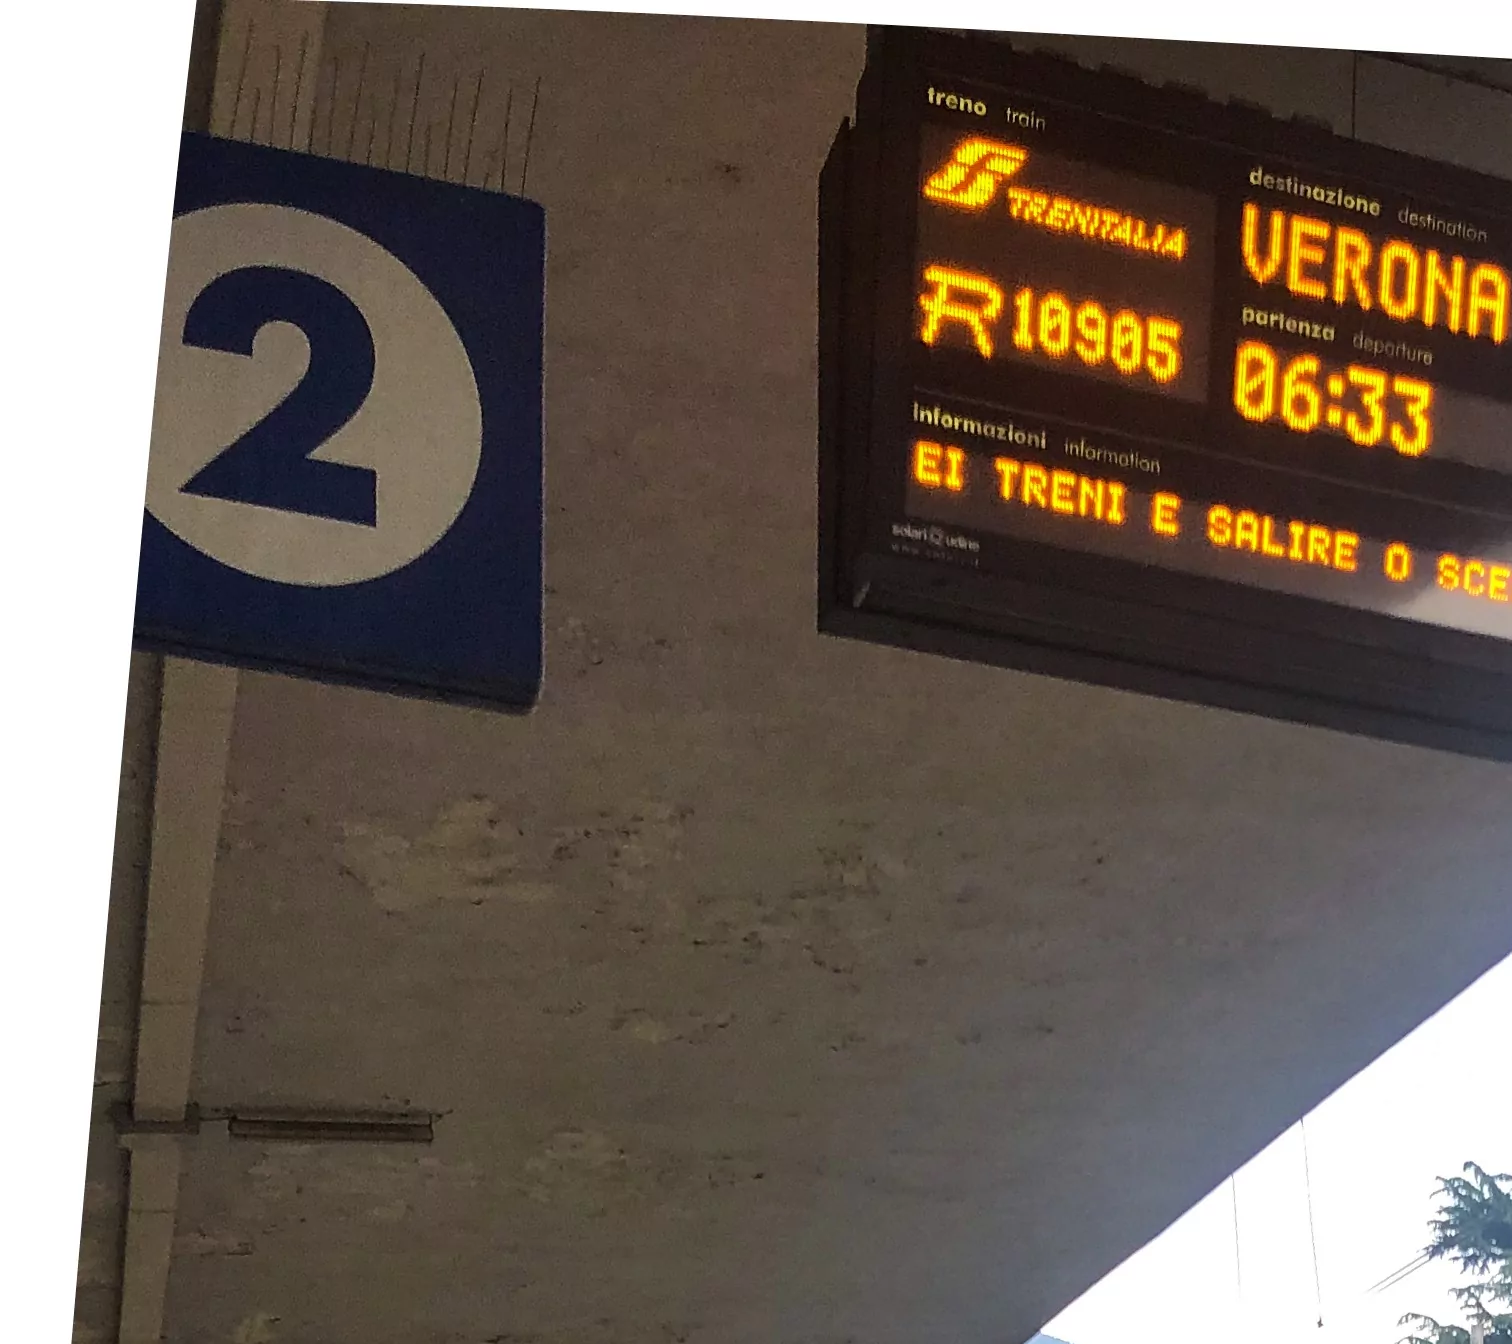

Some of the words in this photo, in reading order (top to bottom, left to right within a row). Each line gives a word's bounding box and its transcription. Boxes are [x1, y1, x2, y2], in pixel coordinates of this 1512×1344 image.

[927, 87, 987, 117] treno
[1006, 106, 1046, 131] train
[1007, 186, 1188, 260] TRENITALIA
[1249, 165, 1381, 217] destinazione
[1398, 206, 1488, 244] destination
[1241, 200, 1511, 347] VERONA
[1012, 286, 1182, 384] 10905
[1242, 304, 1335, 342] partenza
[1352, 330, 1433, 366] departure
[177, 264, 378, 529] 2
[912, 401, 1047, 450] informazioni
[1064, 437, 1161, 475] information
[1234, 338, 1435, 458] 06:33
[913, 439, 966, 492] EI
[993, 456, 1127, 526] TRENI
[1152, 490, 1182, 537] E
[1206, 503, 1360, 573] SALIRE
[1383, 541, 1412, 583] O
